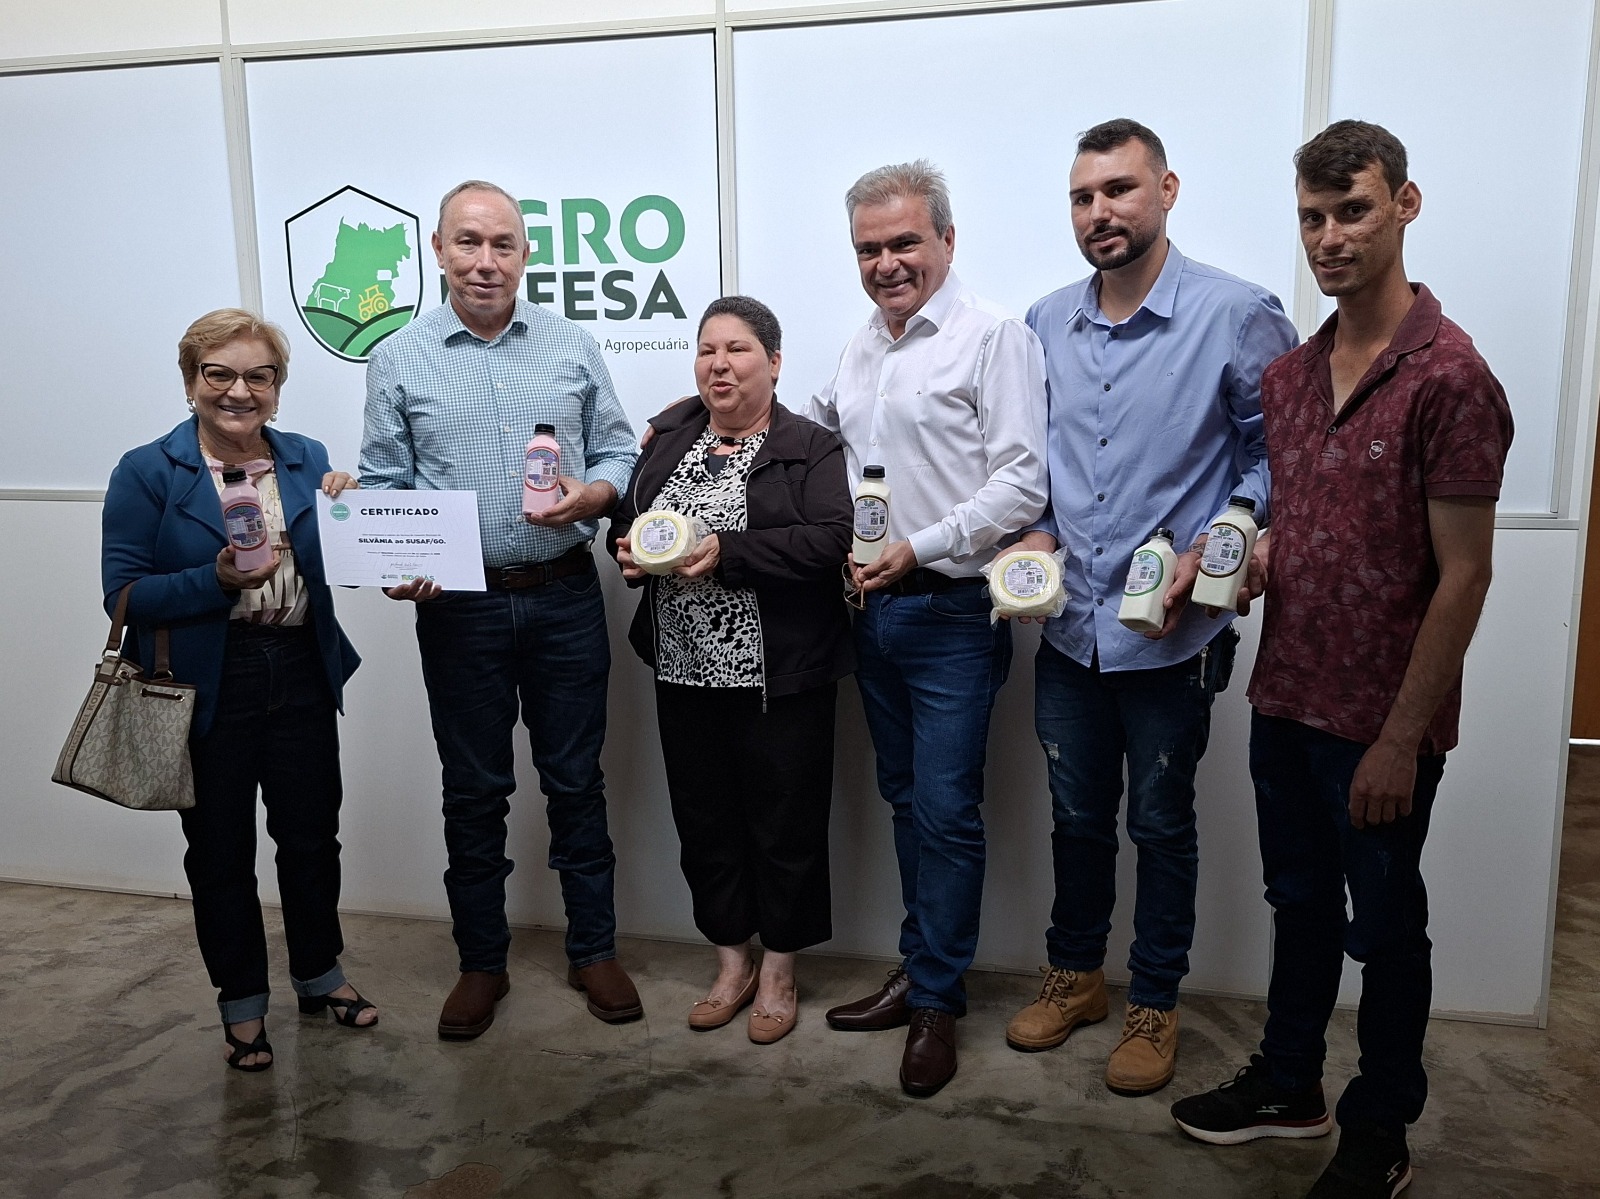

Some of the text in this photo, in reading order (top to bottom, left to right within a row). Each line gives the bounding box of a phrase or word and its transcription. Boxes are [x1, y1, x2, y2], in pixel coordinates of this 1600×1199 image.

[519, 194, 686, 266] GRO
[604, 338, 689, 354] Agropecuária
[360, 508, 439, 516] CERTIFICADO
[67, 683, 105, 758] MICHAEL KORS
